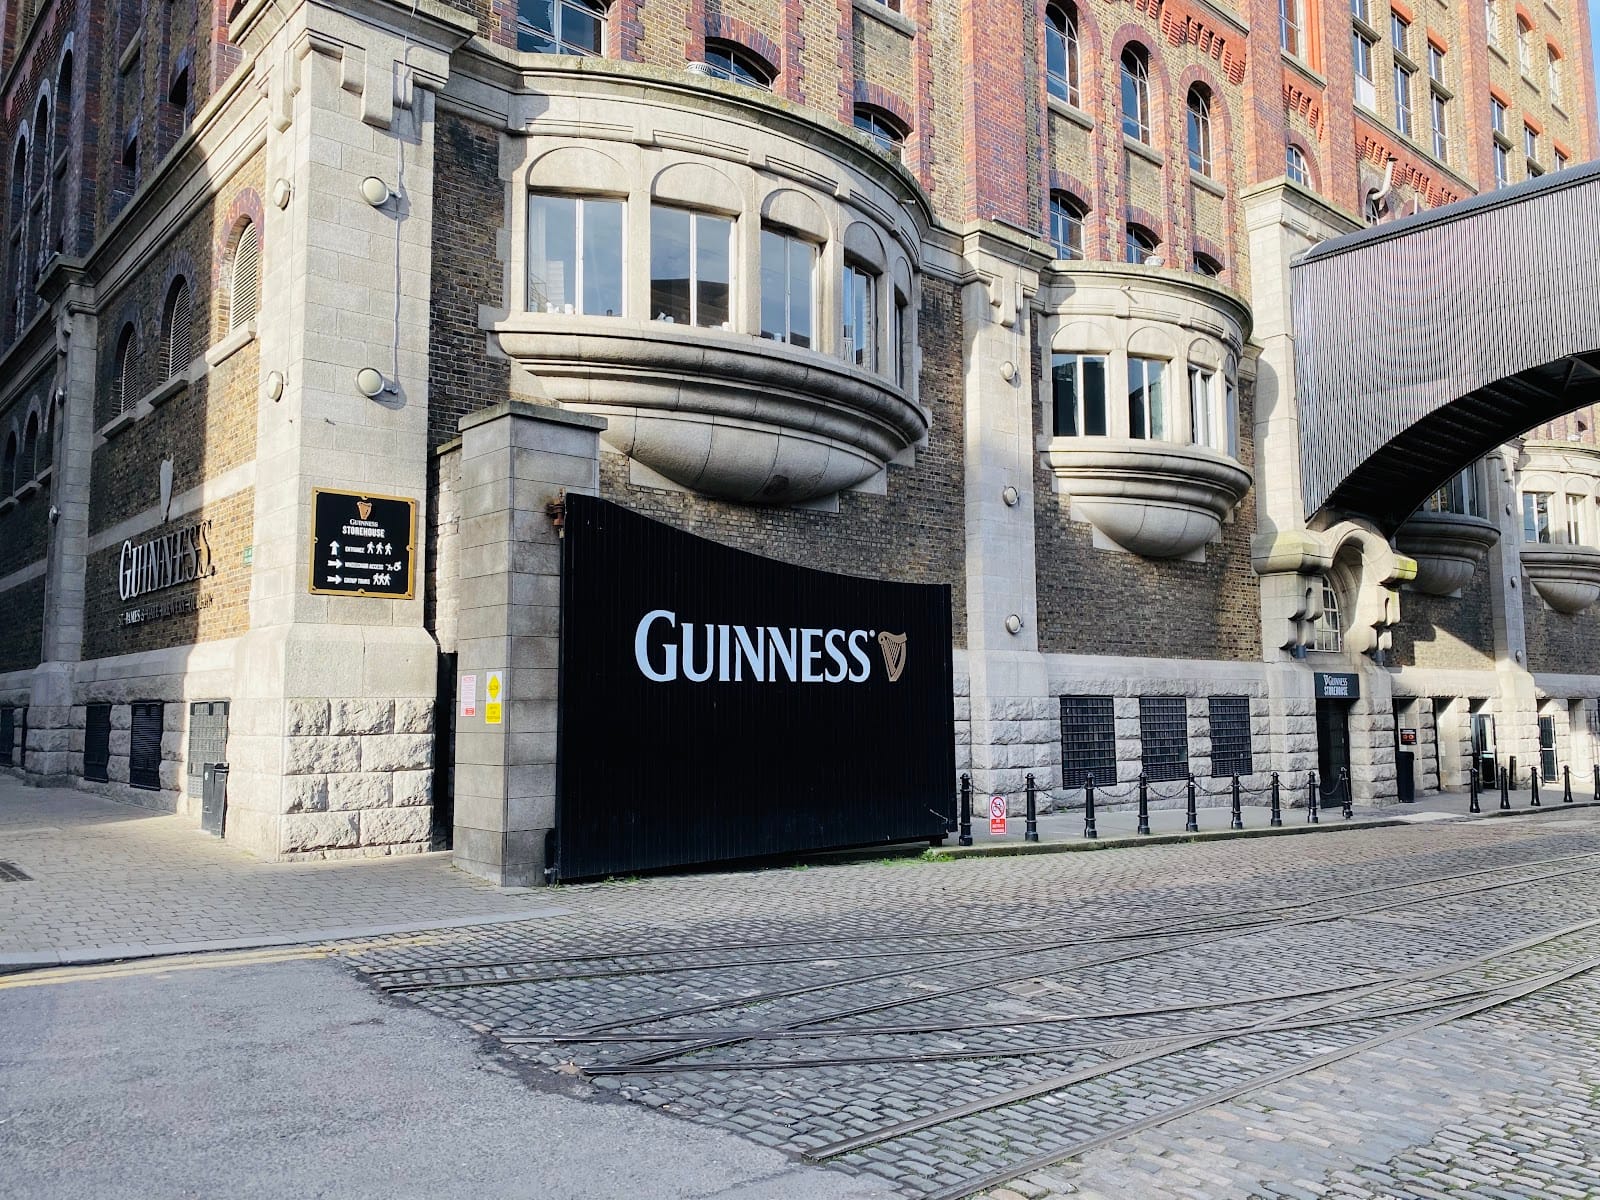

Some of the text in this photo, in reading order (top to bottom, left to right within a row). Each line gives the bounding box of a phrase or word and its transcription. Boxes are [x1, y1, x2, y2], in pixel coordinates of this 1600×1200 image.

[350, 519, 378, 527] GUINNESS
[342, 525, 386, 538] STOREHOUSE
[119, 520, 211, 601] GUINNESS
[634, 609, 871, 683] GUINNESS
[1327, 675, 1348, 686] GUINNESS
